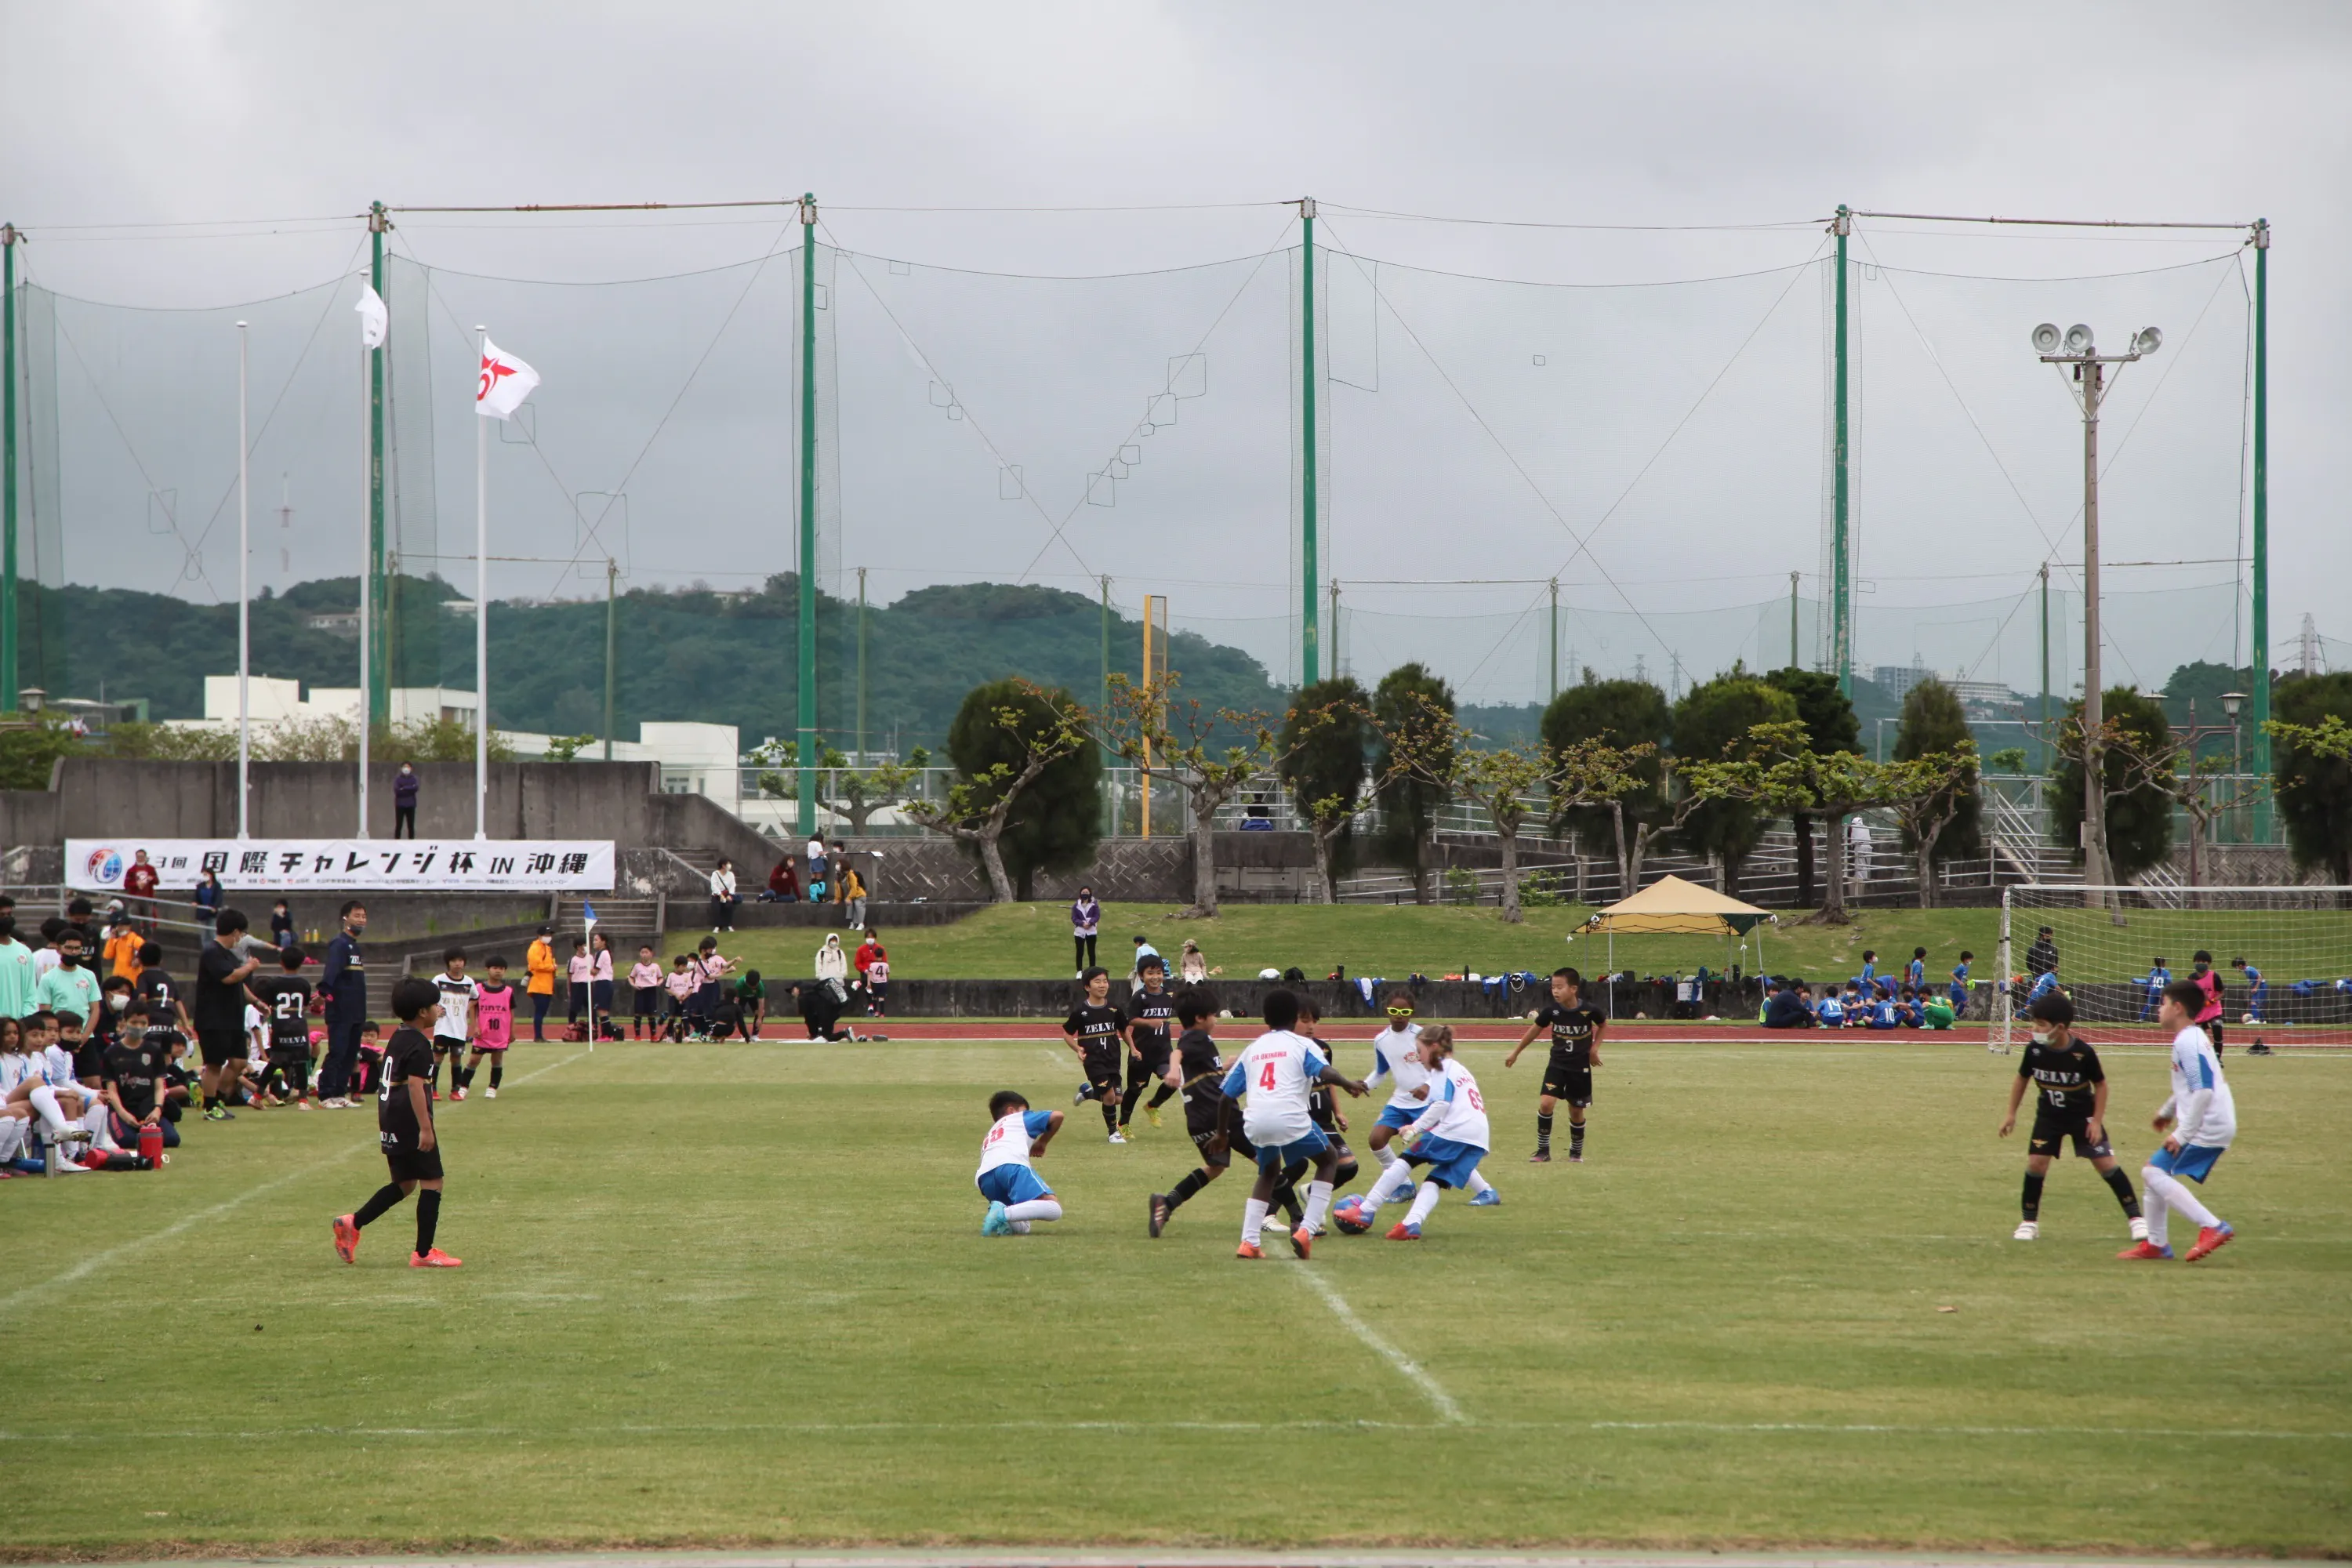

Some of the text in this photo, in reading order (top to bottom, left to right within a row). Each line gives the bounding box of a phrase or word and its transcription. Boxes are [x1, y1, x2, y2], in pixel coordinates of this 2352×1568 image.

[201, 846, 477, 873] 国際チャレンジ杯
[488, 857, 514, 874] IN
[525, 853, 588, 874] 沖縄
[876, 965, 884, 977] 4
[2153, 976, 2164, 989] 10
[157, 983, 168, 1007] 7
[277, 993, 303, 1018] 27
[1828, 1000, 1842, 1012] 14
[1885, 1008, 1895, 1022] 10
[488, 1018, 500, 1030] 10
[1553, 1024, 1588, 1034] ZELVA
[279, 1036, 307, 1044] ZELVA
[1100, 1037, 1106, 1050] 4
[1566, 1040, 1573, 1052] 3
[380, 1055, 393, 1102] 9
[1260, 1062, 1276, 1091] 4
[2032, 1067, 2081, 1083] ZELVA
[2046, 1089, 2066, 1108] 12
